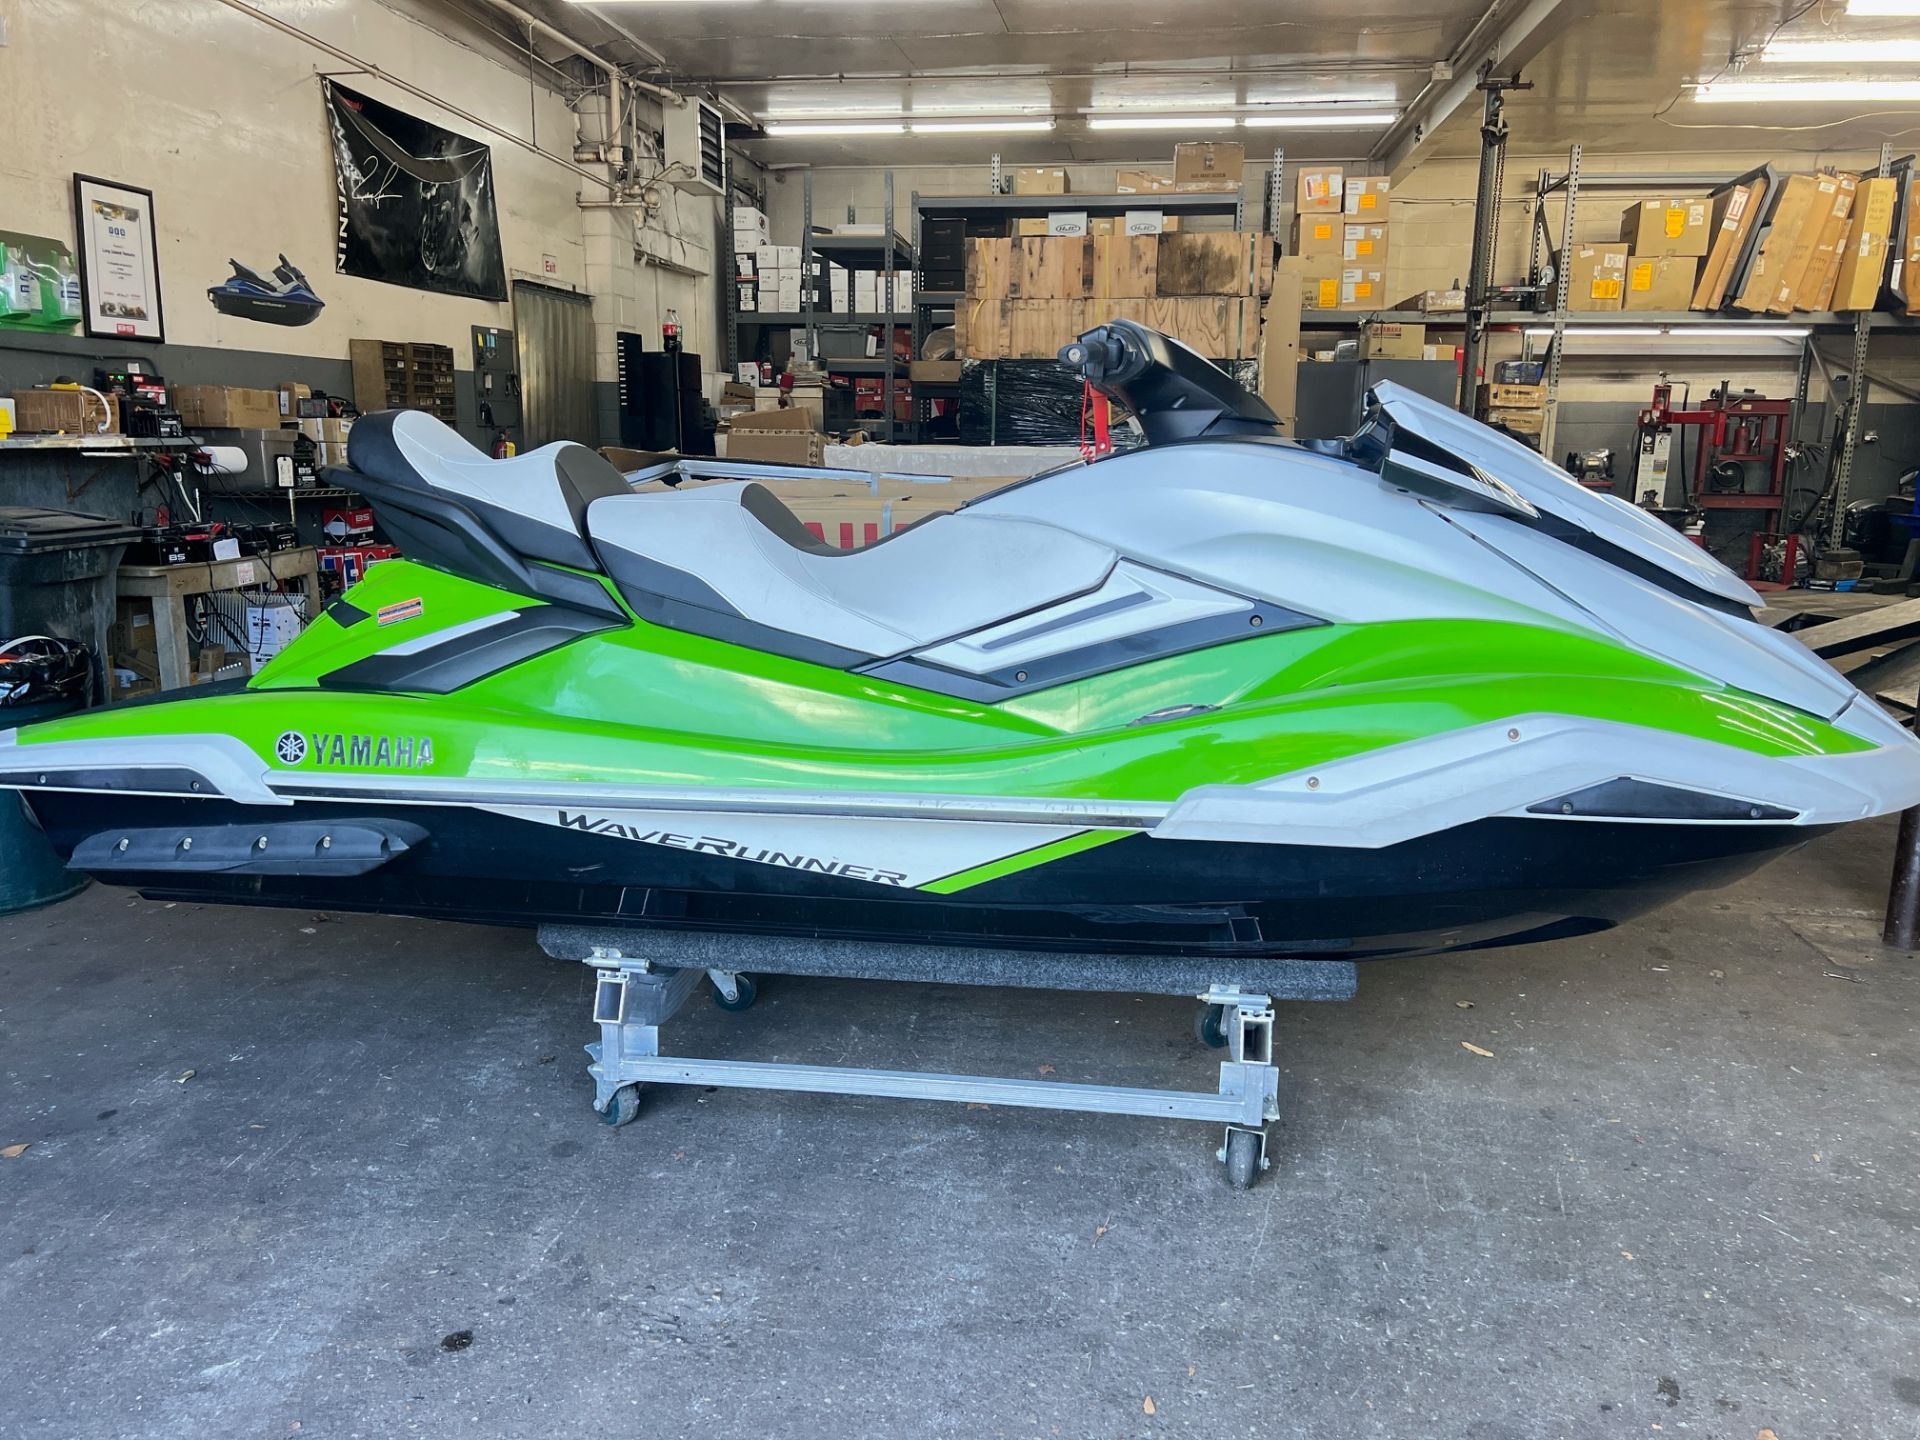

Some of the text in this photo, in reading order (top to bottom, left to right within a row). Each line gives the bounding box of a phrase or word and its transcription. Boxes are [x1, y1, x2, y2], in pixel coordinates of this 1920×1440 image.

[335, 174, 350, 274] NINJA
[355, 513, 369, 522] BS
[168, 553, 186, 562] BS
[312, 733, 433, 768] YAMAHA
